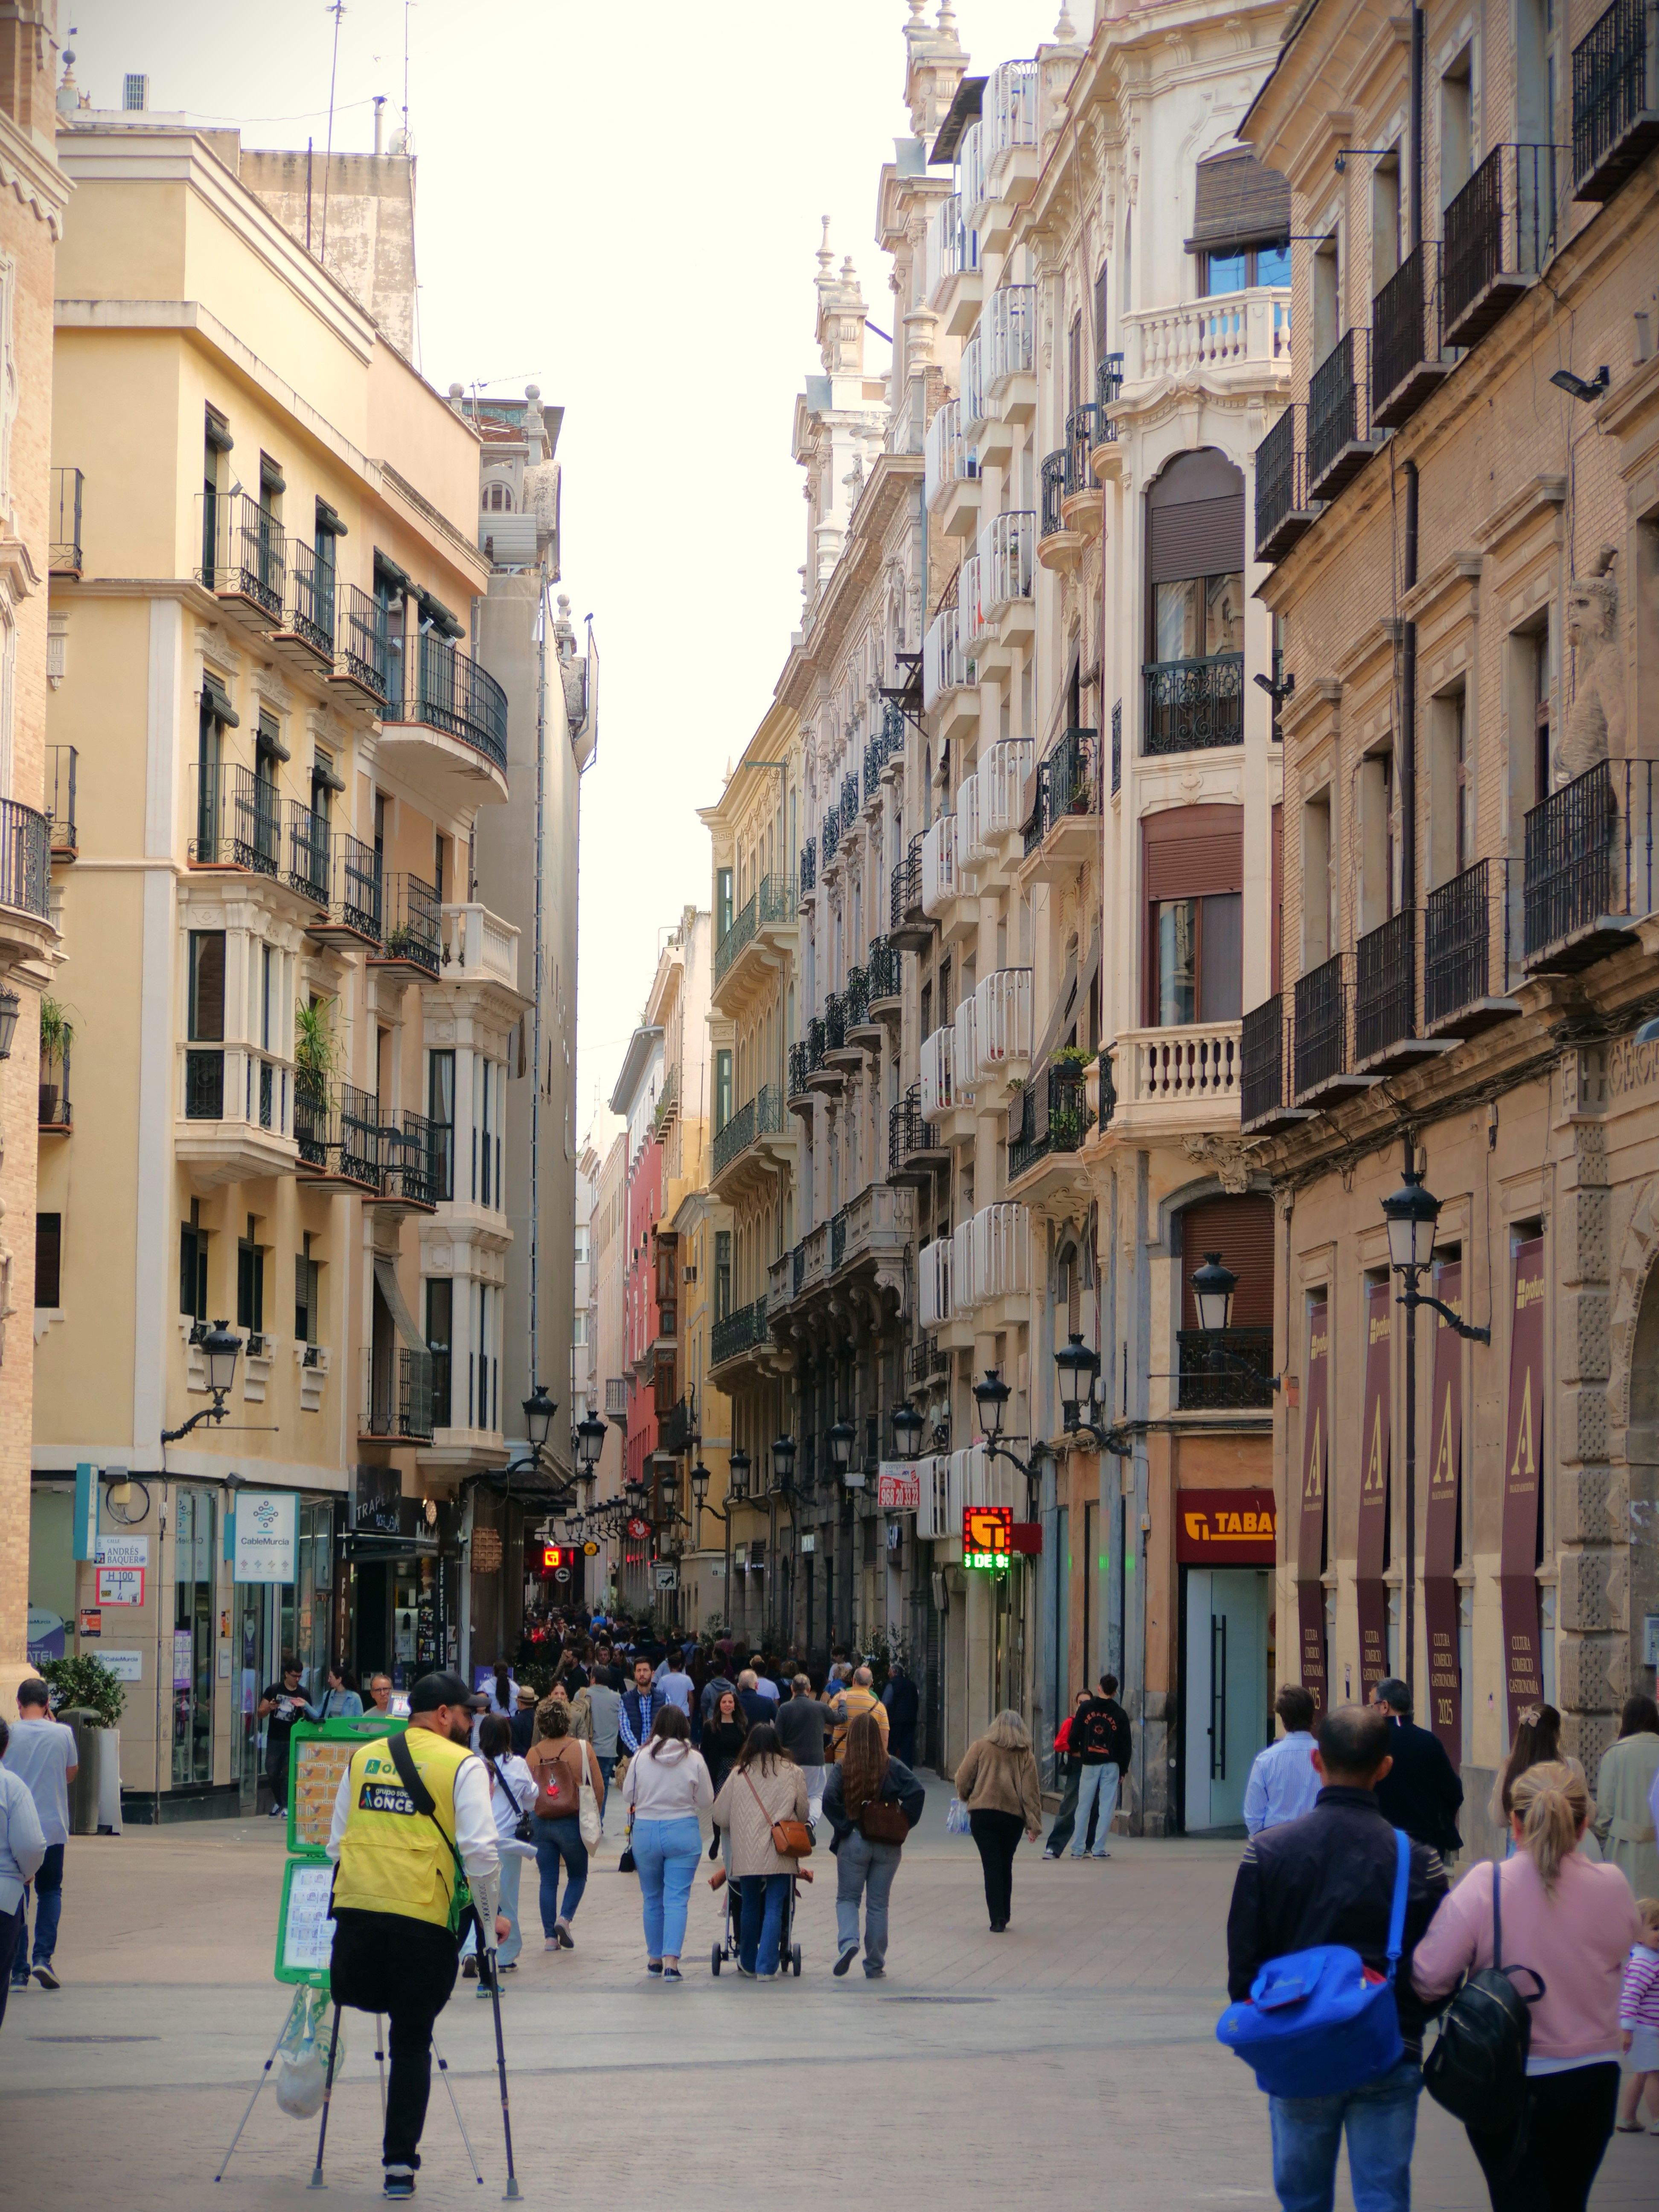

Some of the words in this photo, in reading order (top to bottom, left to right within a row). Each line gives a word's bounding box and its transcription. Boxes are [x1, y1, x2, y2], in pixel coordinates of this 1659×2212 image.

[881, 1488, 894, 1505] 968
[896, 1488, 903, 1505] 20
[905, 1488, 911, 1505] 33
[912, 1488, 919, 1505] 22
[1215, 1513, 1277, 1532] TABA
[241, 1537, 289, 1545] CableMurcia
[108, 1545, 139, 1555] ANDRÉS
[108, 1556, 146, 1565] BAQUER
[975, 1554, 992, 1568] DE
[108, 1572, 114, 1580] H
[119, 1572, 133, 1580] 100
[117, 1592, 122, 1601] 4
[1365, 1630, 1380, 1643] CULTURA
[1433, 1633, 1450, 1647] CULTURA
[1512, 1636, 1531, 1650] CULTURA
[1365, 1650, 1382, 1662] COMERCIO
[1433, 1653, 1452, 1667] COMERCIO
[1512, 1658, 1533, 1673] COMERCIO
[1432, 1671, 1457, 1688] GASTRONOMÍA
[1509, 1676, 1539, 1695] GASTRONOMÍA
[1438, 1699, 1453, 1725] 2025
[375, 1788, 396, 1796] grupo
[373, 1796, 414, 1813] ONCE
